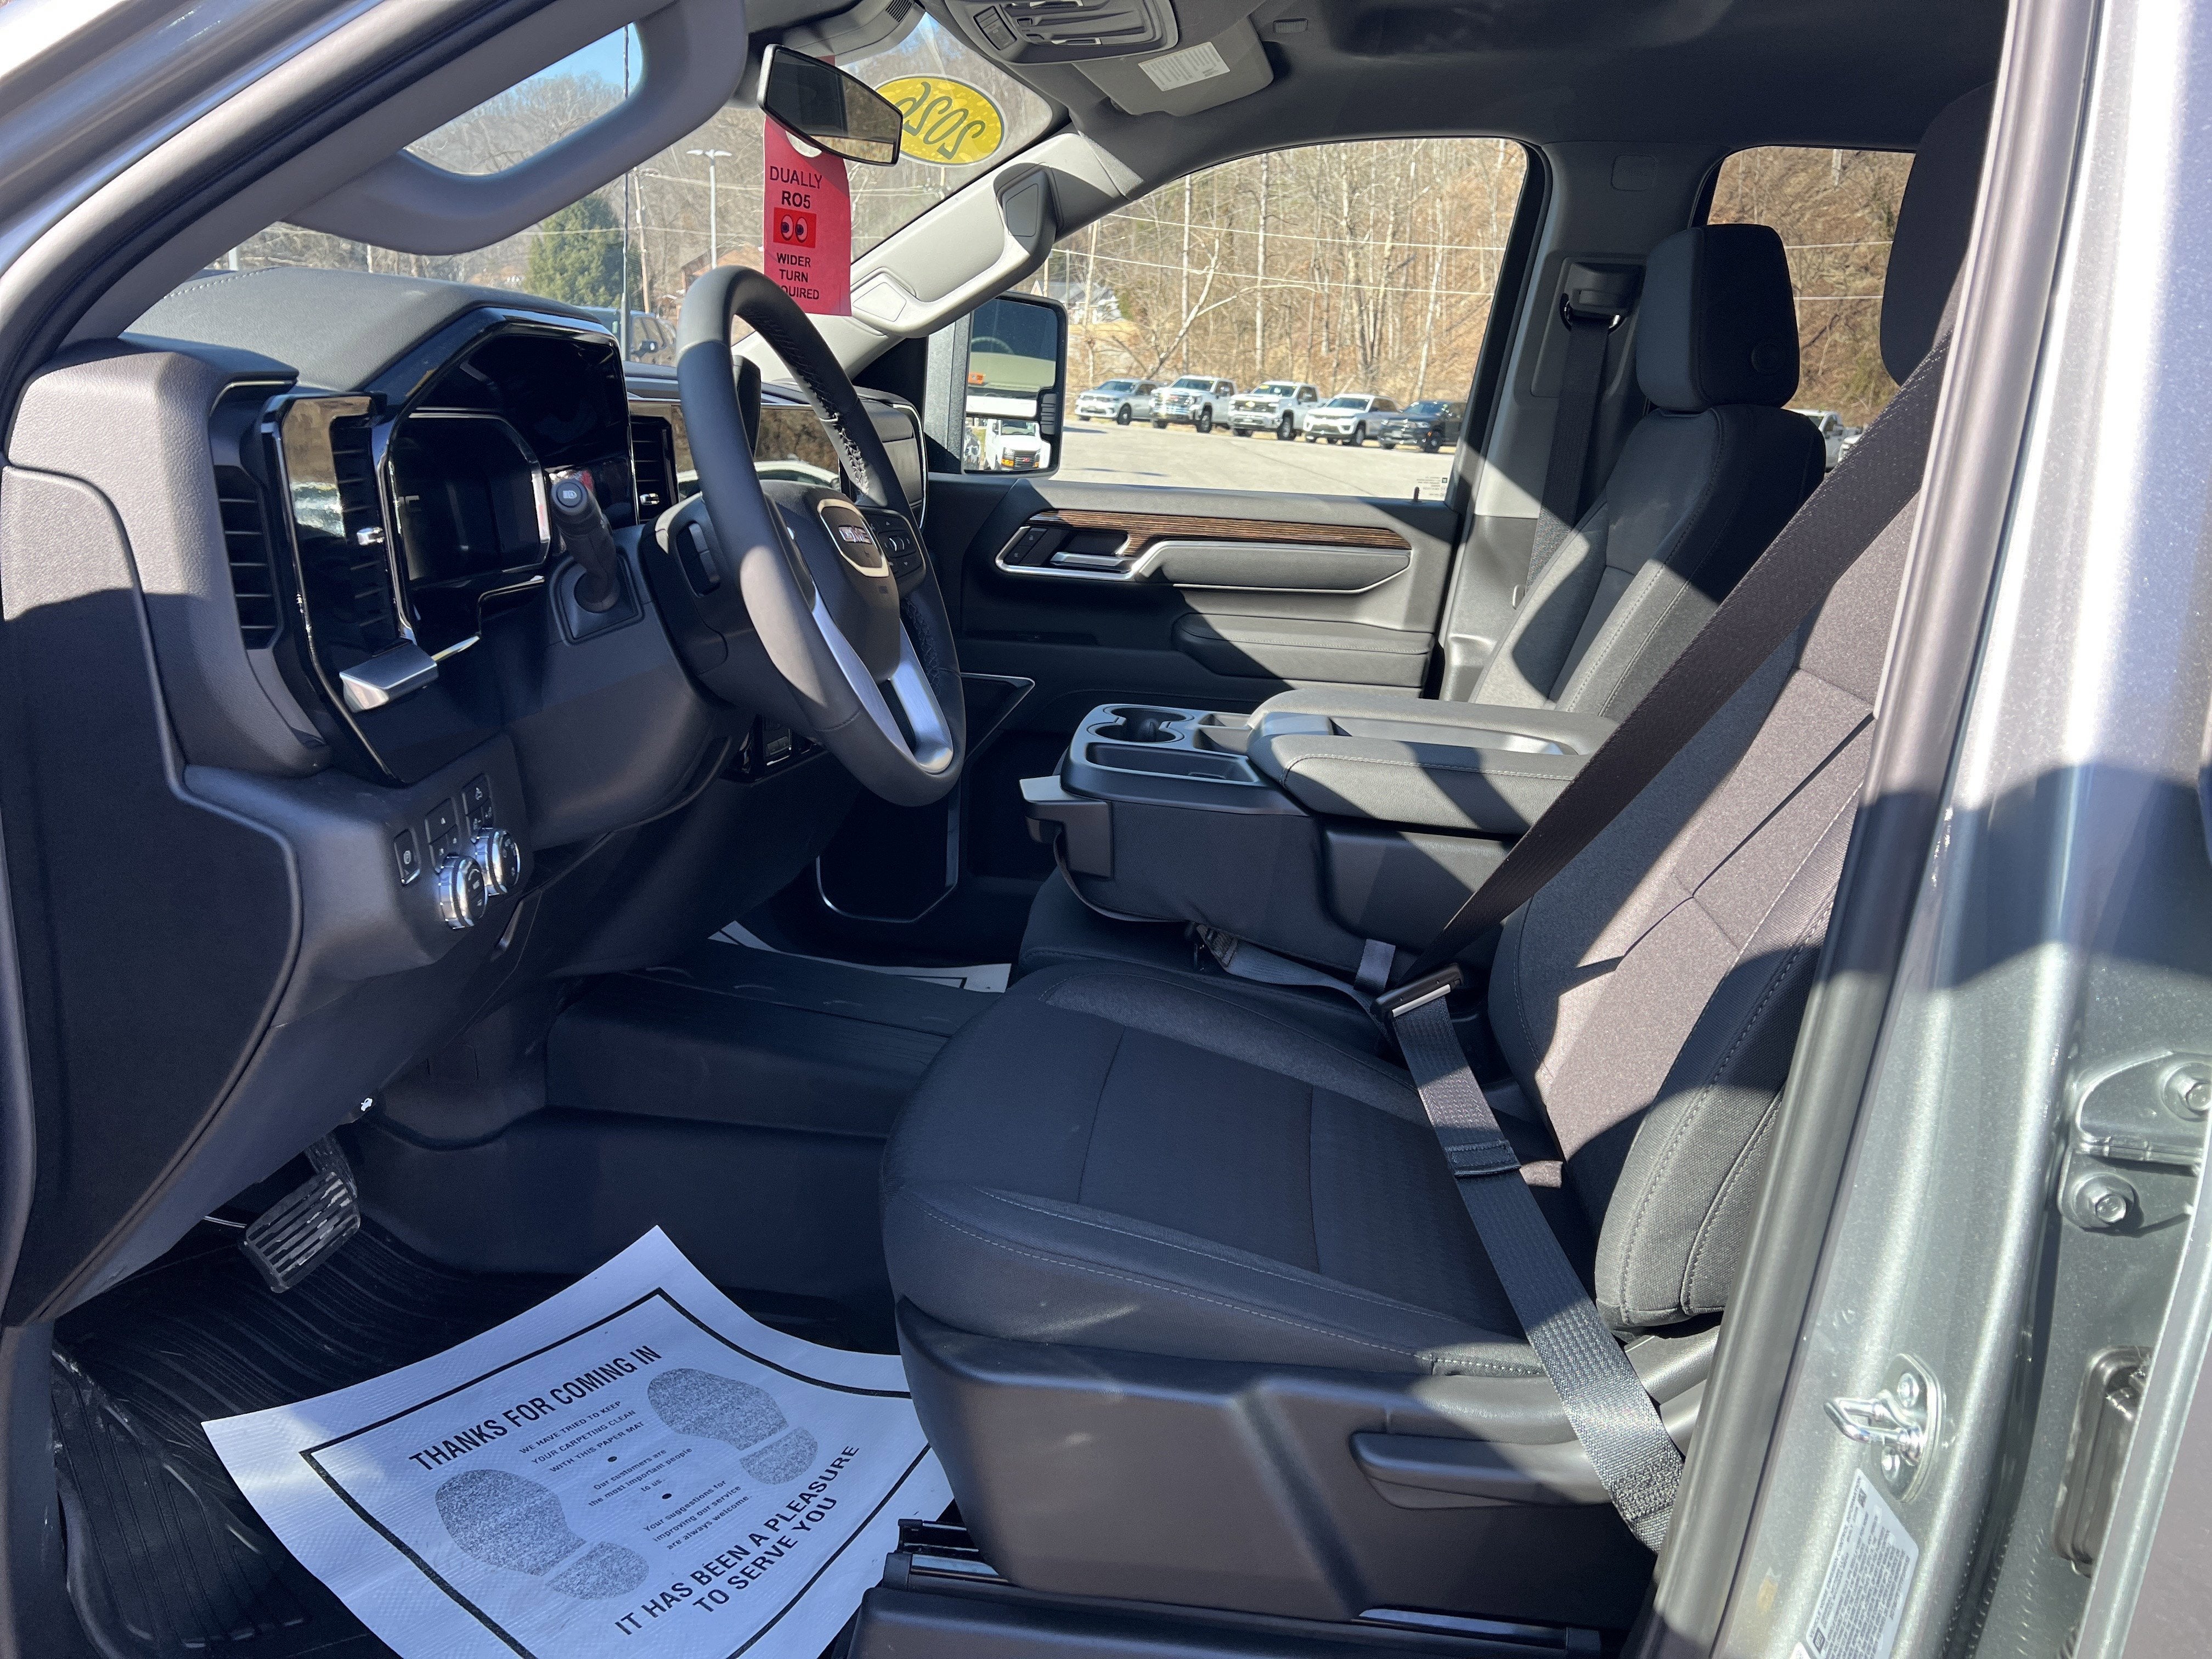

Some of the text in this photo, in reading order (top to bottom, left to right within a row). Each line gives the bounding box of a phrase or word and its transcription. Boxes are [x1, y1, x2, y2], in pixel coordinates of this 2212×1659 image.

[770, 166, 822, 189] DUALLY
[777, 252, 811, 267] WIDER
[779, 269, 808, 283] TURN
[838, 526, 872, 544] GMC
[409, 1345, 662, 1470] THANKS FOR COMING IN
[519, 1401, 621, 1454] WE HAVE TRIED TO KEEP
[532, 1410, 636, 1464] YOUR CARPETING CLEAN
[550, 1421, 645, 1472] WITH THIS PAPER MAT
[588, 1448, 692, 1506] the most important people
[594, 1449, 667, 1489] Our customers are
[643, 1480, 726, 1532] Your suggestions for
[652, 1486, 741, 1542] improving our service
[615, 1446, 859, 1635] IT HAS BEEN A PLEASURE
[667, 1540, 682, 1549] are
[684, 1521, 713, 1541] always
[692, 1497, 837, 1612] TO SERVE YOU
[1809, 1608, 1821, 1640] VEHICLE
[1819, 1588, 1828, 1610] NOISE
[1826, 1555, 1838, 1589] EMISSION
[1836, 1523, 1848, 1556] CONTROL
[1845, 1474, 1862, 1523] INFORMATION
